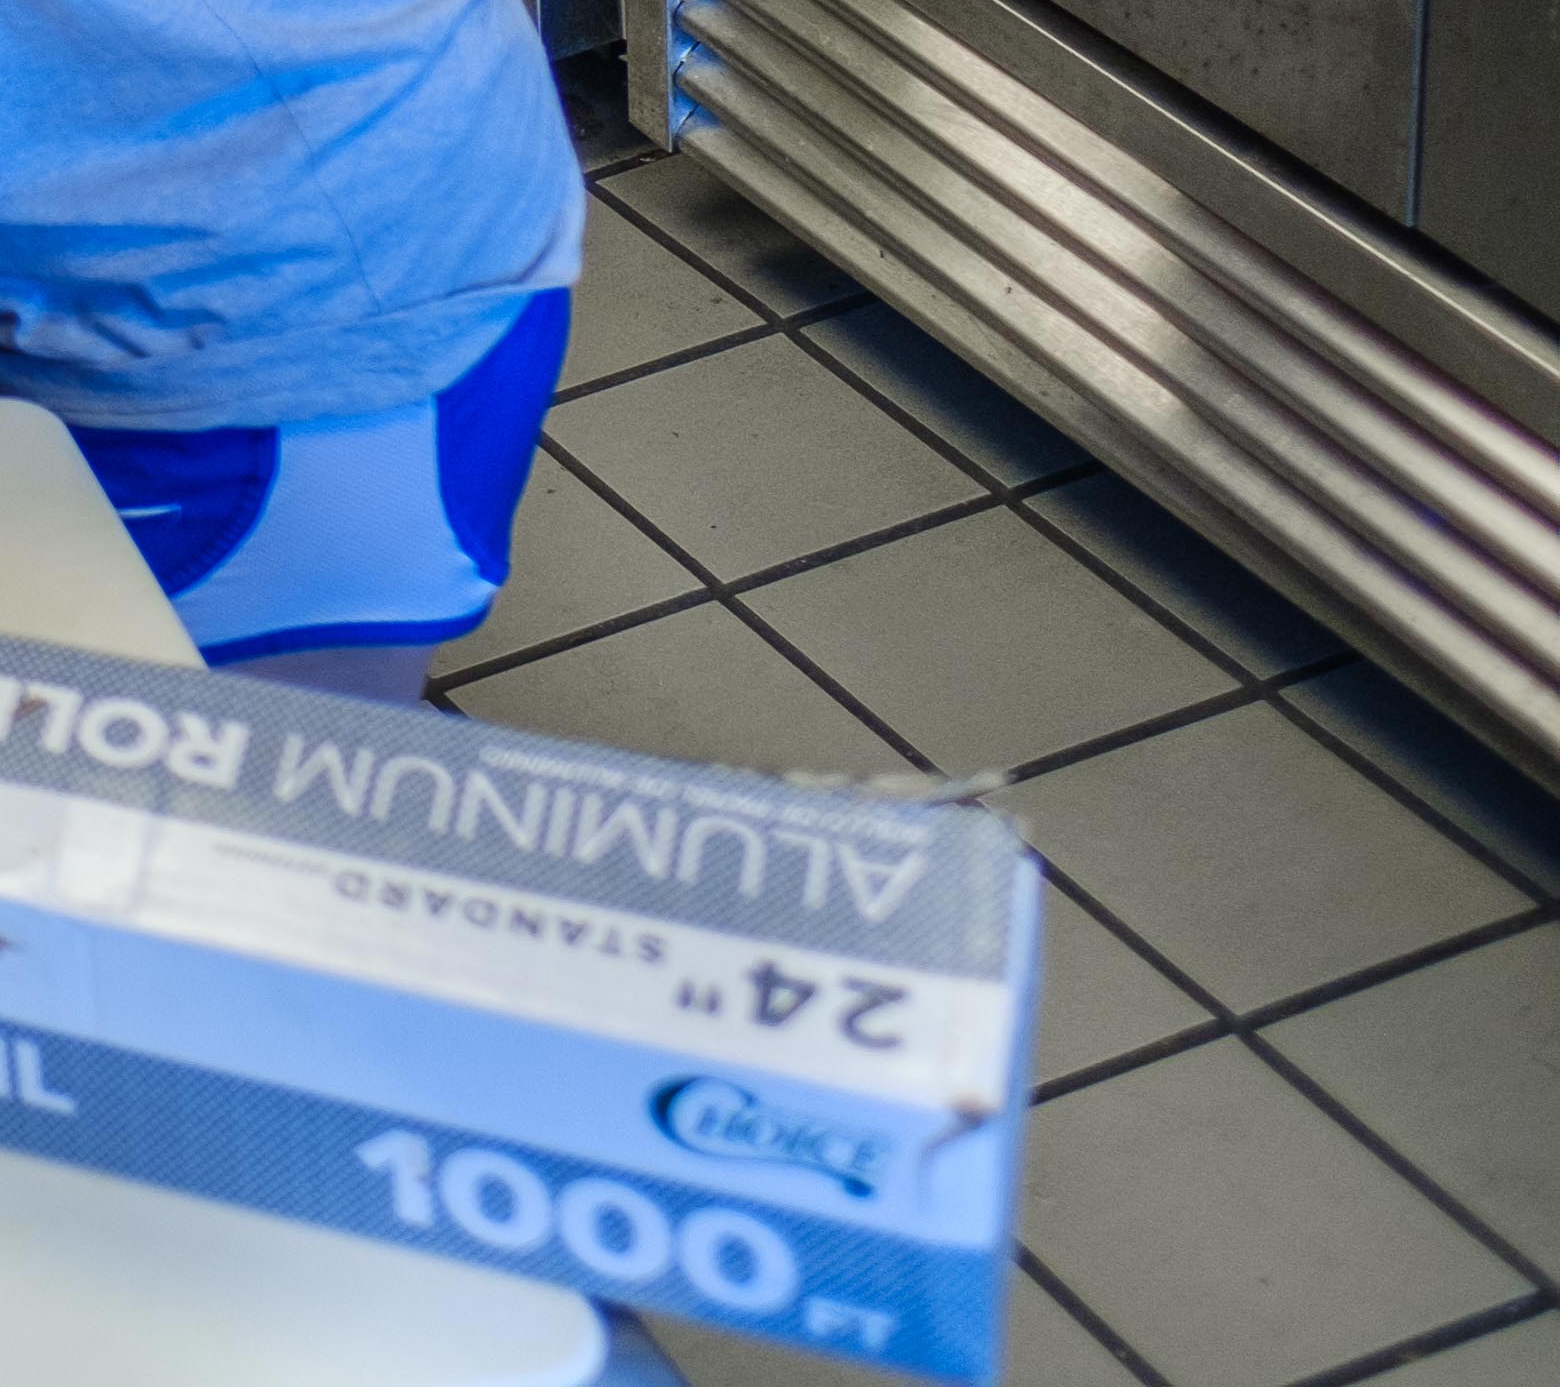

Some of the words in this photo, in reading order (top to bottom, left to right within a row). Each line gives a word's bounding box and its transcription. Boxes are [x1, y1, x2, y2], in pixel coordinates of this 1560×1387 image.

[271, 730, 928, 923] ALUMINUM
[330, 868, 667, 966] STANDARD
[674, 957, 911, 1053] 24"
[642, 1073, 892, 1202] CHOICE
[354, 1127, 801, 1312] 1000
[802, 1293, 897, 1353] FT
